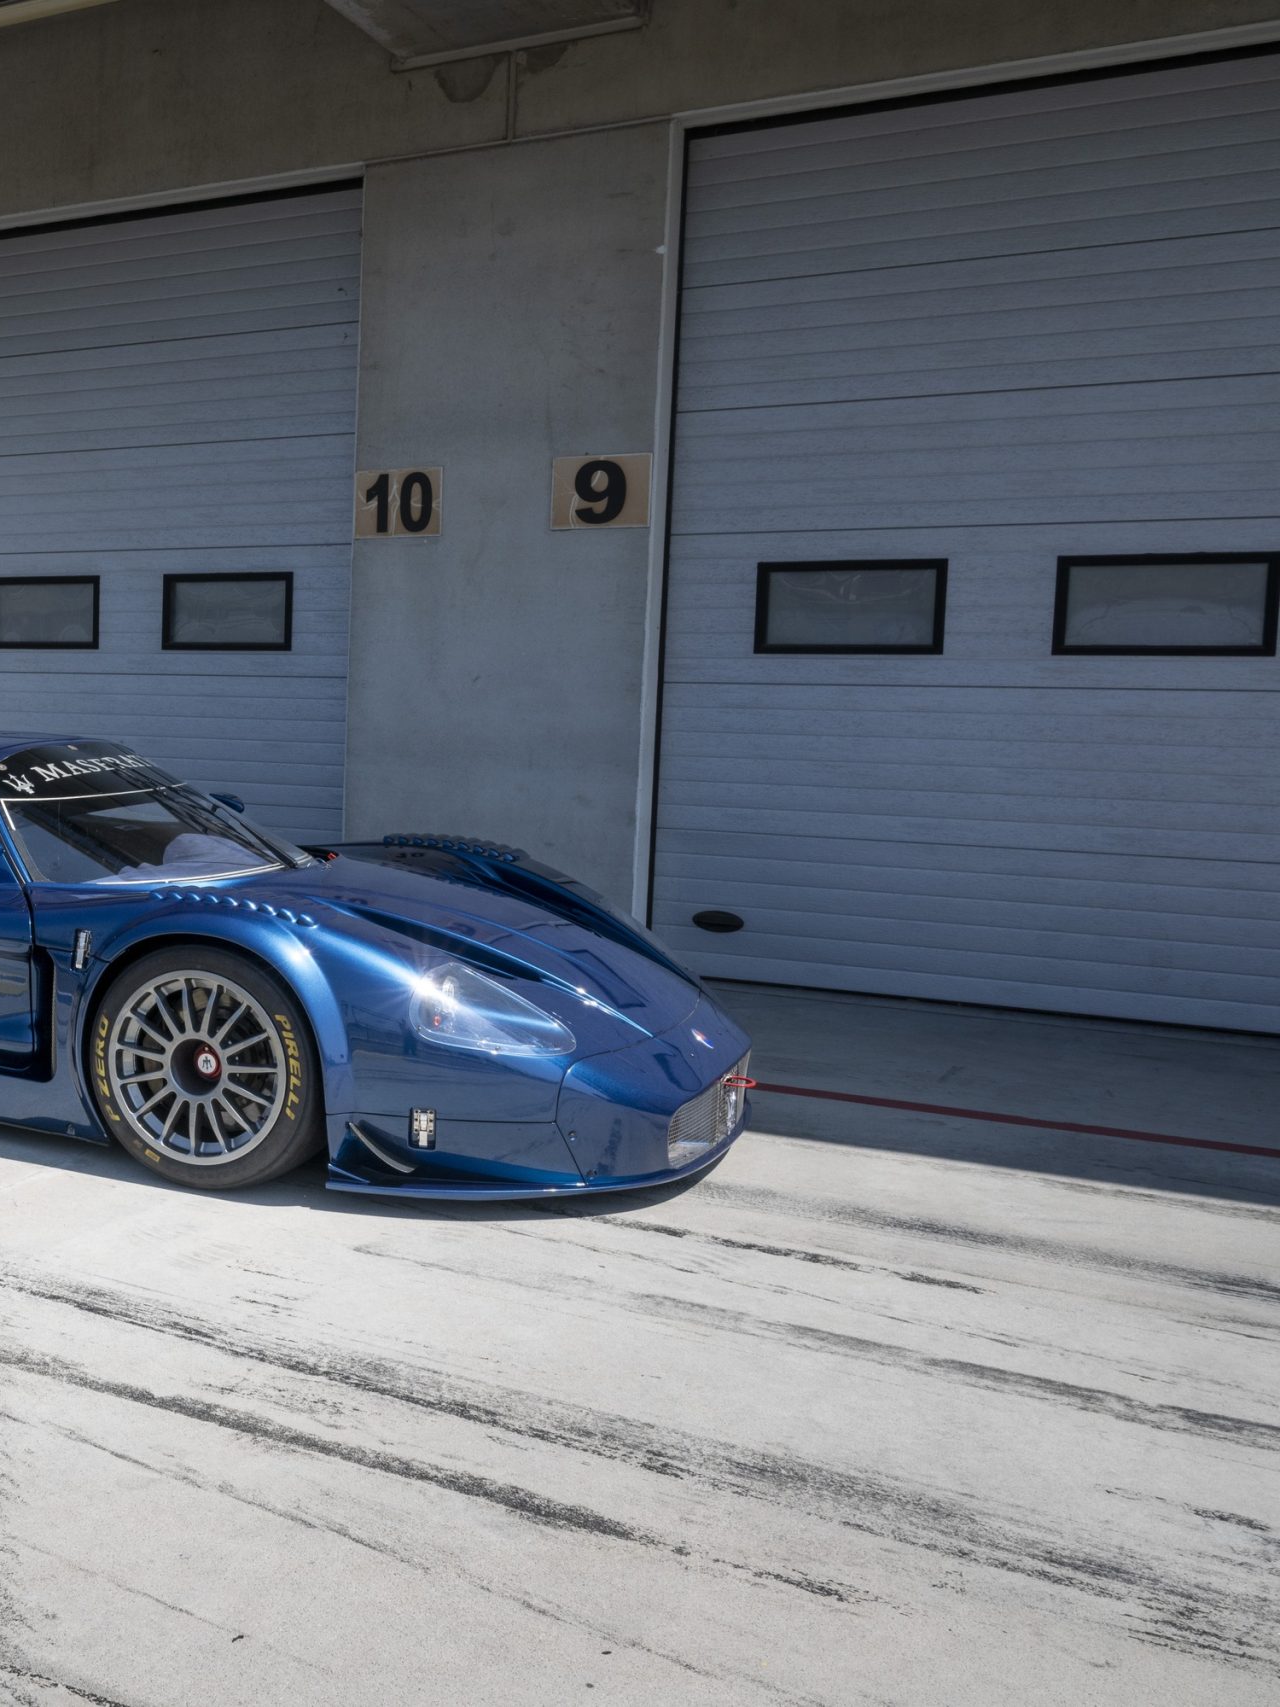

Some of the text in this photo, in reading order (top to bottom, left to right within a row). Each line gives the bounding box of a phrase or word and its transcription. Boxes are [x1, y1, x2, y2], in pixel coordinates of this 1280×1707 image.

[365, 471, 433, 533] 10
[574, 459, 627, 525] 9
[30, 754, 153, 782] MASERAT
[93, 1014, 121, 1122] P ZERO
[275, 1014, 302, 1121] PIRELLI
